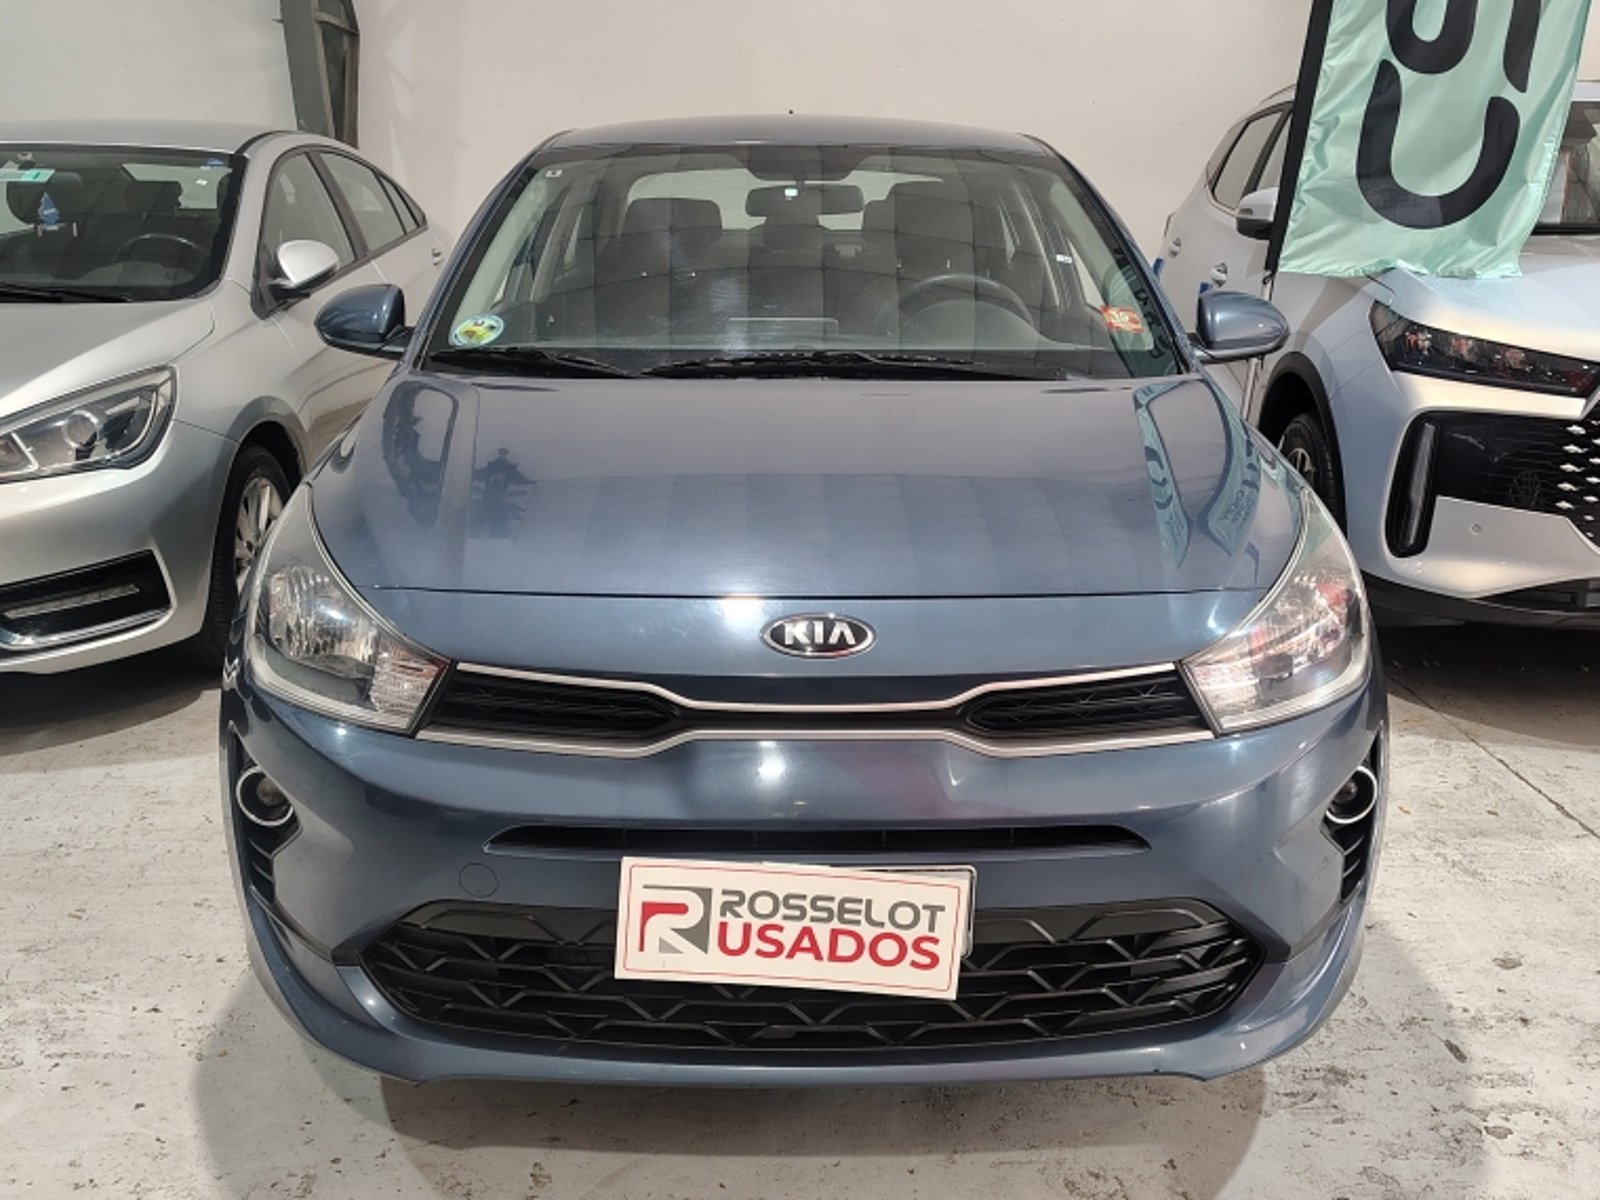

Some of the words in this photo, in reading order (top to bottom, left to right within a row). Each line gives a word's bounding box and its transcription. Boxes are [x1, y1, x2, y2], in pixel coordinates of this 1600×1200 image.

[784, 620, 856, 645] KIA
[719, 888, 946, 933] ROSSELOT
[717, 921, 940, 971] USADOS
